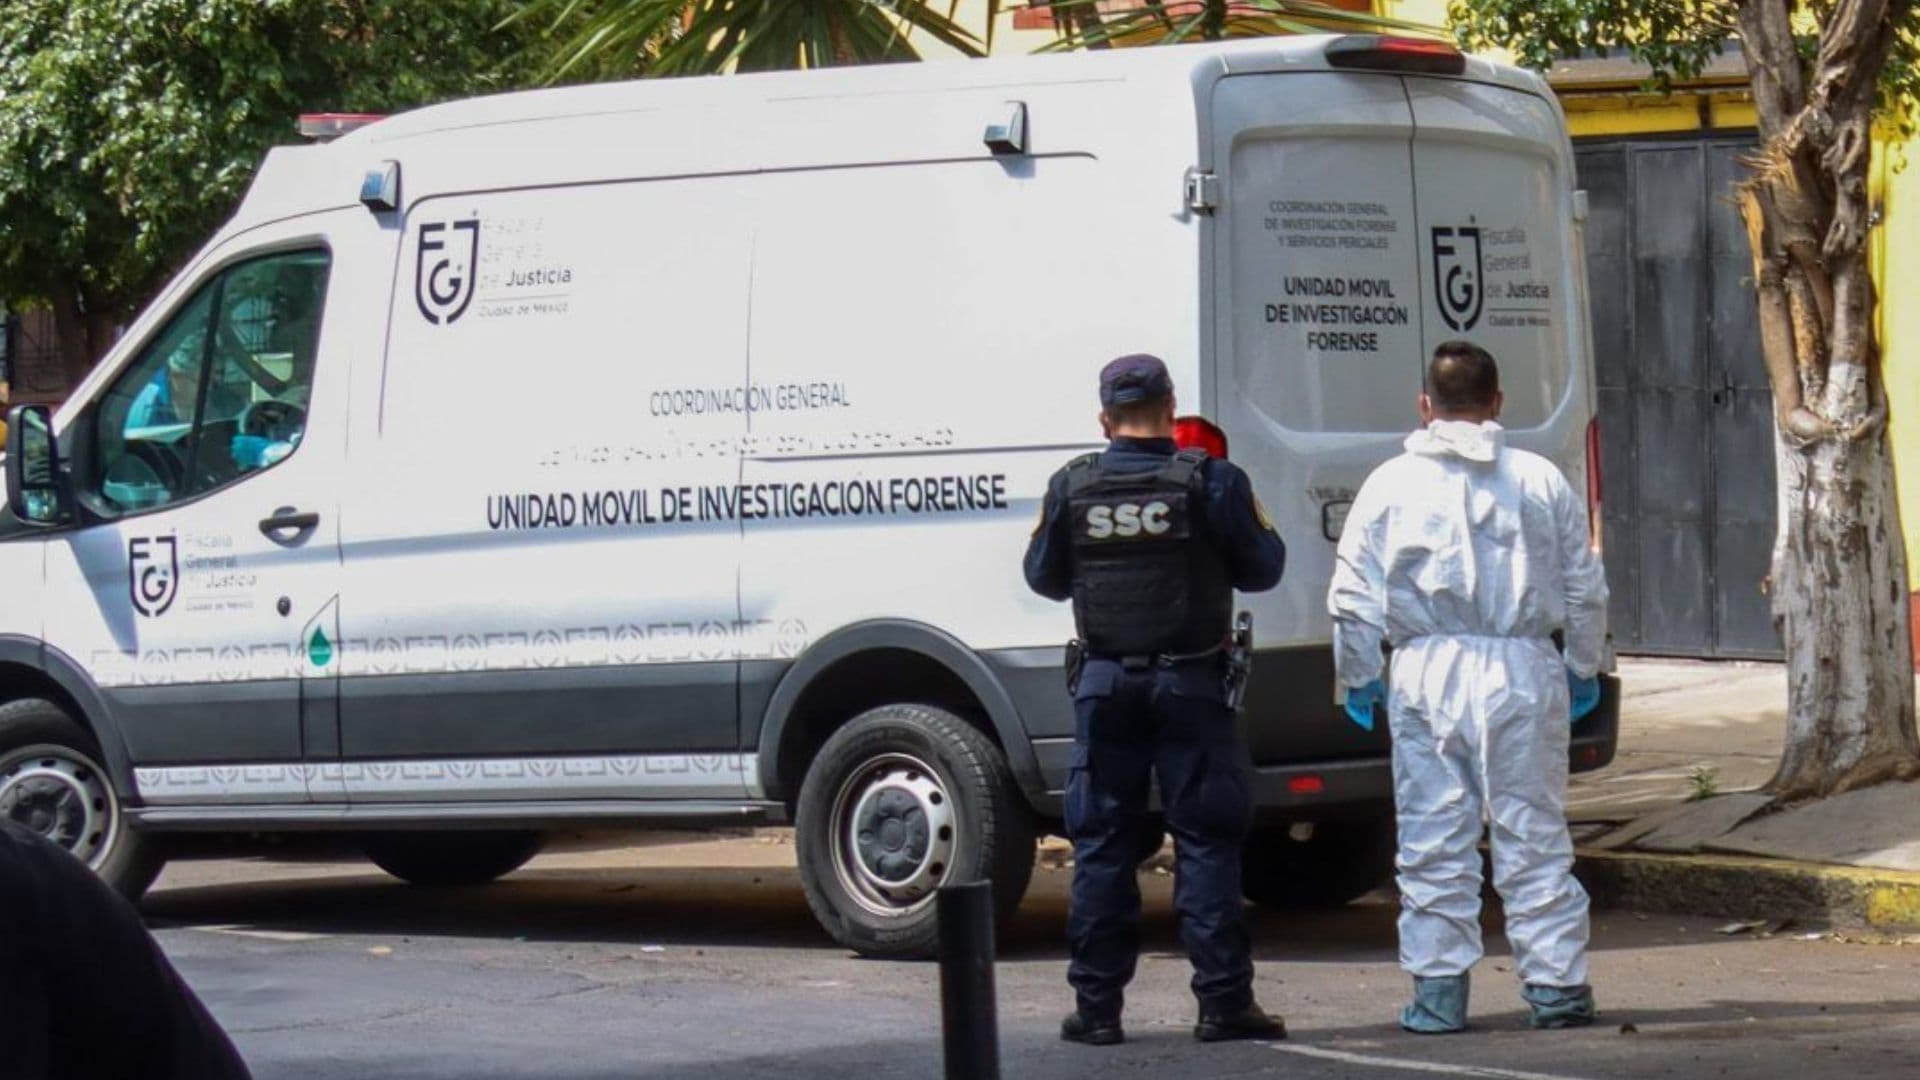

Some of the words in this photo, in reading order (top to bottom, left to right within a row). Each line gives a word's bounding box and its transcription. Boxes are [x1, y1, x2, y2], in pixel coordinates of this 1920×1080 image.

[506, 268, 572, 287] Justicia
[1284, 276, 1345, 297] UNIDAD
[1506, 279, 1550, 299] Justicia
[1265, 303, 1290, 323] DE
[1307, 332, 1379, 351] FORENSE
[776, 382, 850, 411] GENERAL
[487, 493, 576, 530] UNIDAD
[582, 489, 656, 526] MOVIL
[661, 487, 693, 522] DE
[889, 474, 1008, 513] FORENSE
[1086, 502, 1170, 538] SSC
